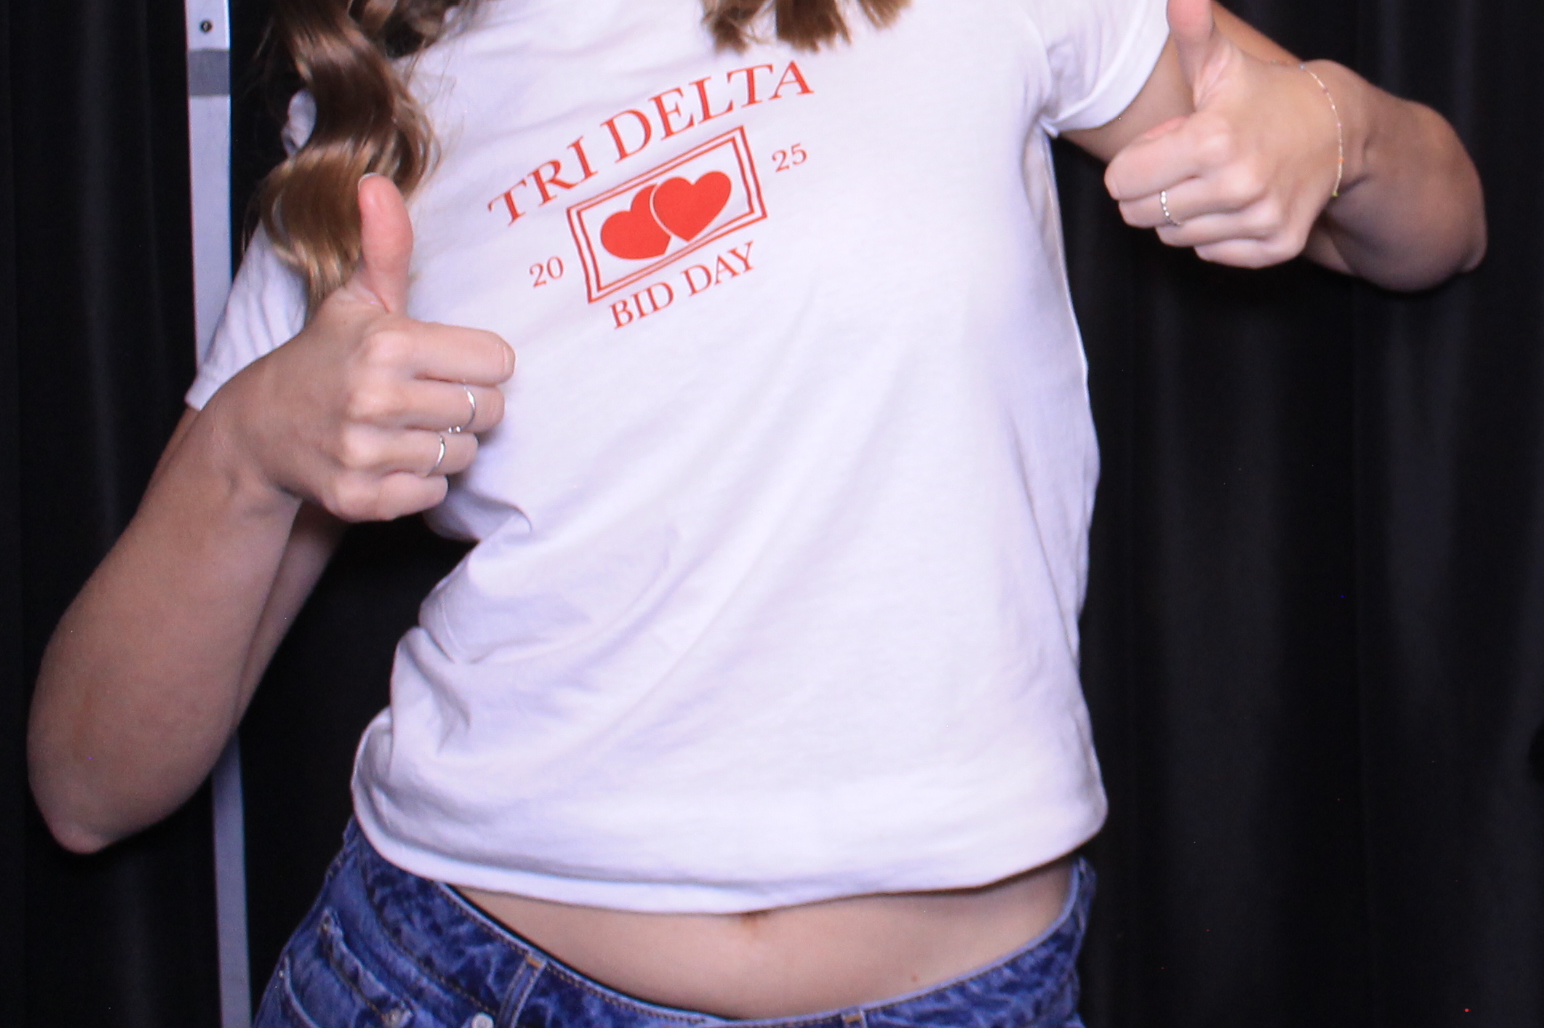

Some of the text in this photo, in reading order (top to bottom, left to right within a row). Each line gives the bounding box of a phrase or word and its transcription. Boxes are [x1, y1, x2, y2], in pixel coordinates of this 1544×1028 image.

[487, 60, 815, 227] TRI DELTA
[771, 142, 808, 173] 25
[528, 256, 565, 288] 20
[608, 240, 755, 330] BID DAY
